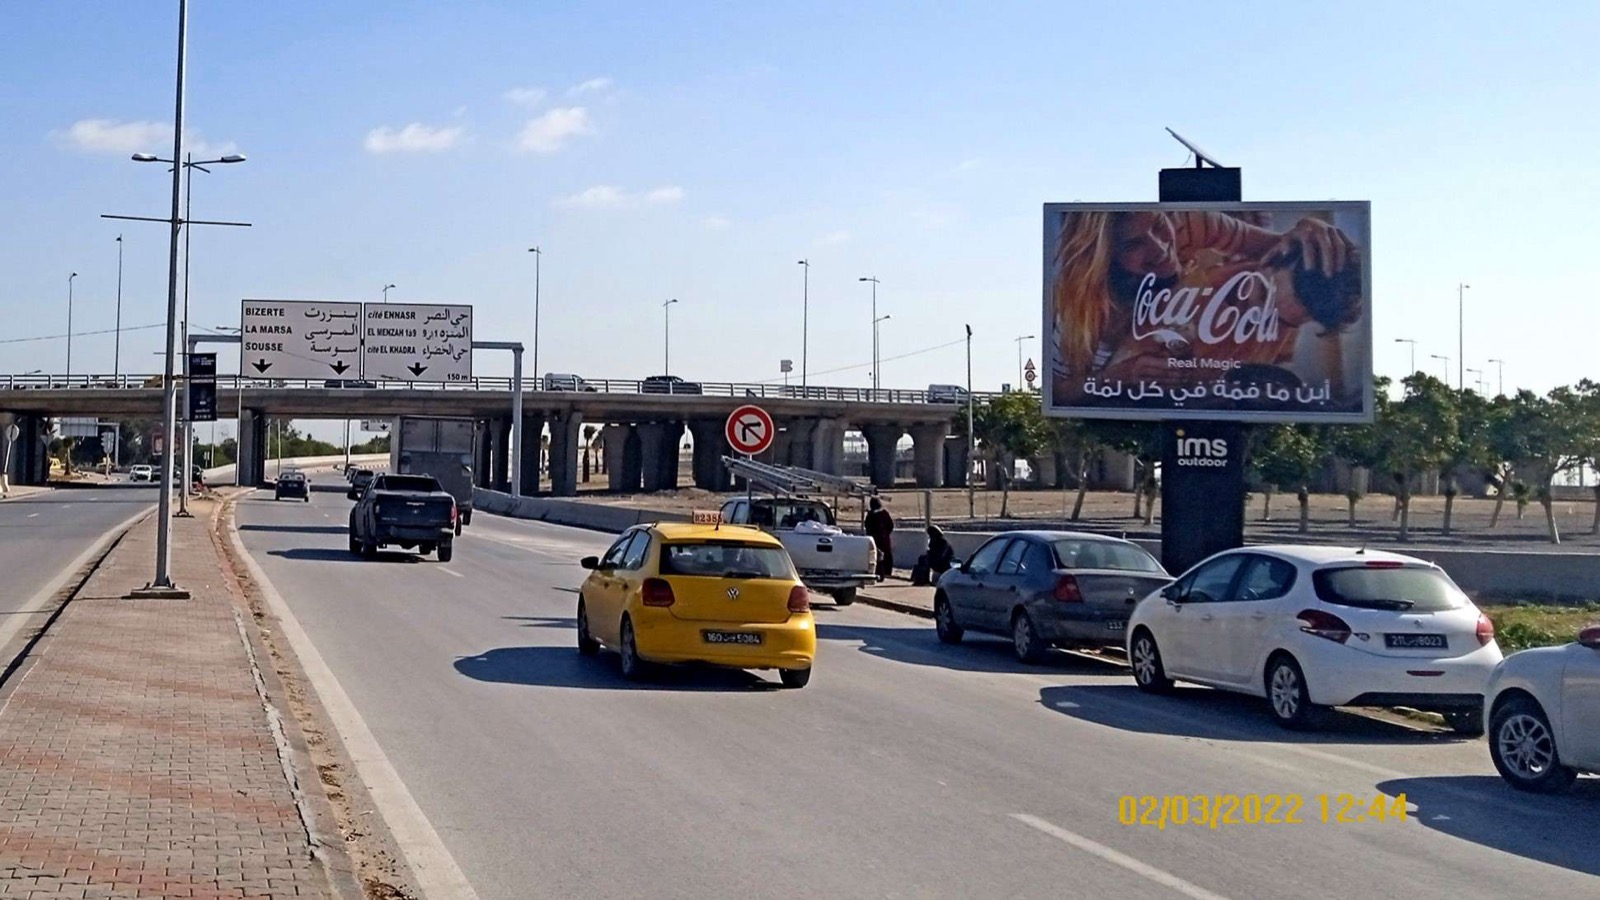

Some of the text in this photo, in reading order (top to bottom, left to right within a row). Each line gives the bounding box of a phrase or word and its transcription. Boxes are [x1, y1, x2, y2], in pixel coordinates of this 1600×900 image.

[245, 308, 285, 317] BIZERTE
[304, 307, 358, 323] بنزرت
[1132, 271, 1279, 345] Coca-Cola
[384, 311, 416, 320] ENNASR
[423, 308, 468, 329] حي النصر
[245, 325, 292, 334] LA MARSA
[367, 328, 375, 336] EL
[376, 329, 404, 337] MENZAH
[245, 342, 283, 352] SOUSSE
[310, 341, 358, 357] سوسة
[380, 345, 388, 354] EL
[389, 345, 416, 355] KHADRA
[422, 343, 468, 363] حي الخضراء
[1168, 358, 1241, 371] Real Magic
[447, 373, 460, 381] 150
[1127, 380, 1164, 400] كل
[1170, 381, 1207, 406] في
[1266, 382, 1290, 401] ما
[1176, 429, 1228, 457] ims
[1178, 458, 1228, 467] outdoor
